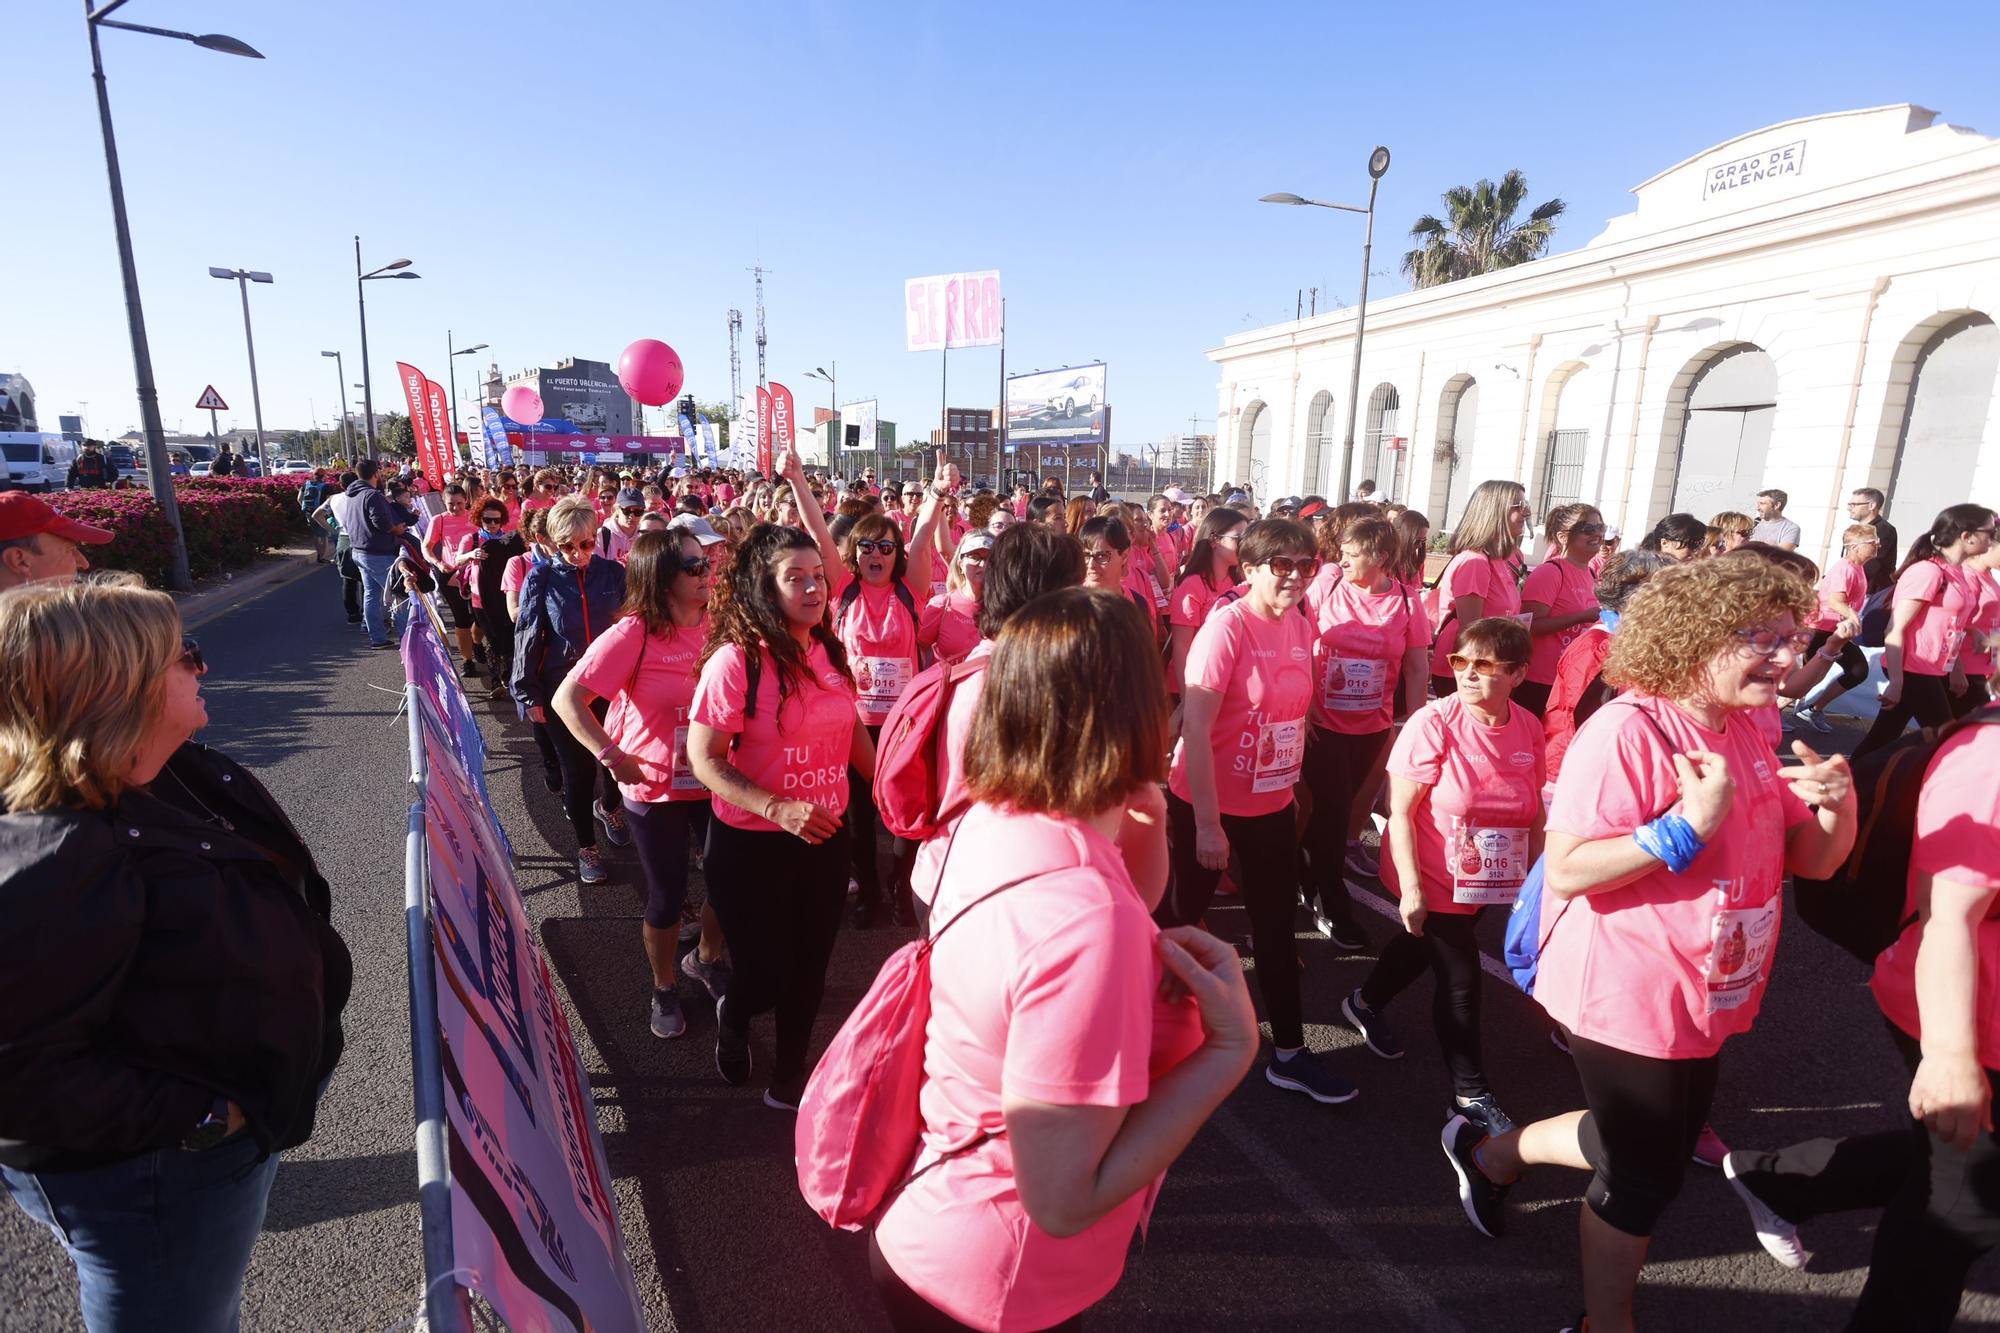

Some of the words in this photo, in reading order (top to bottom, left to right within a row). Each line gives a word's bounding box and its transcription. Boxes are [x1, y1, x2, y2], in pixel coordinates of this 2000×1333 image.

[1715, 159, 1760, 180] GRAO
[1770, 148, 1795, 165] DE
[1710, 161, 1795, 193] VALENCIA
[909, 276, 1000, 345] SERRA
[554, 378, 578, 386] PUERTO
[874, 679, 896, 688] 016
[1347, 680, 1369, 688] 016
[1247, 711, 1271, 728] TU
[784, 745, 809, 765] TU
[1277, 747, 1294, 759] 016
[784, 764, 847, 790] DORSA
[1484, 858, 1508, 868] 016
[1712, 876, 1745, 906] TU
